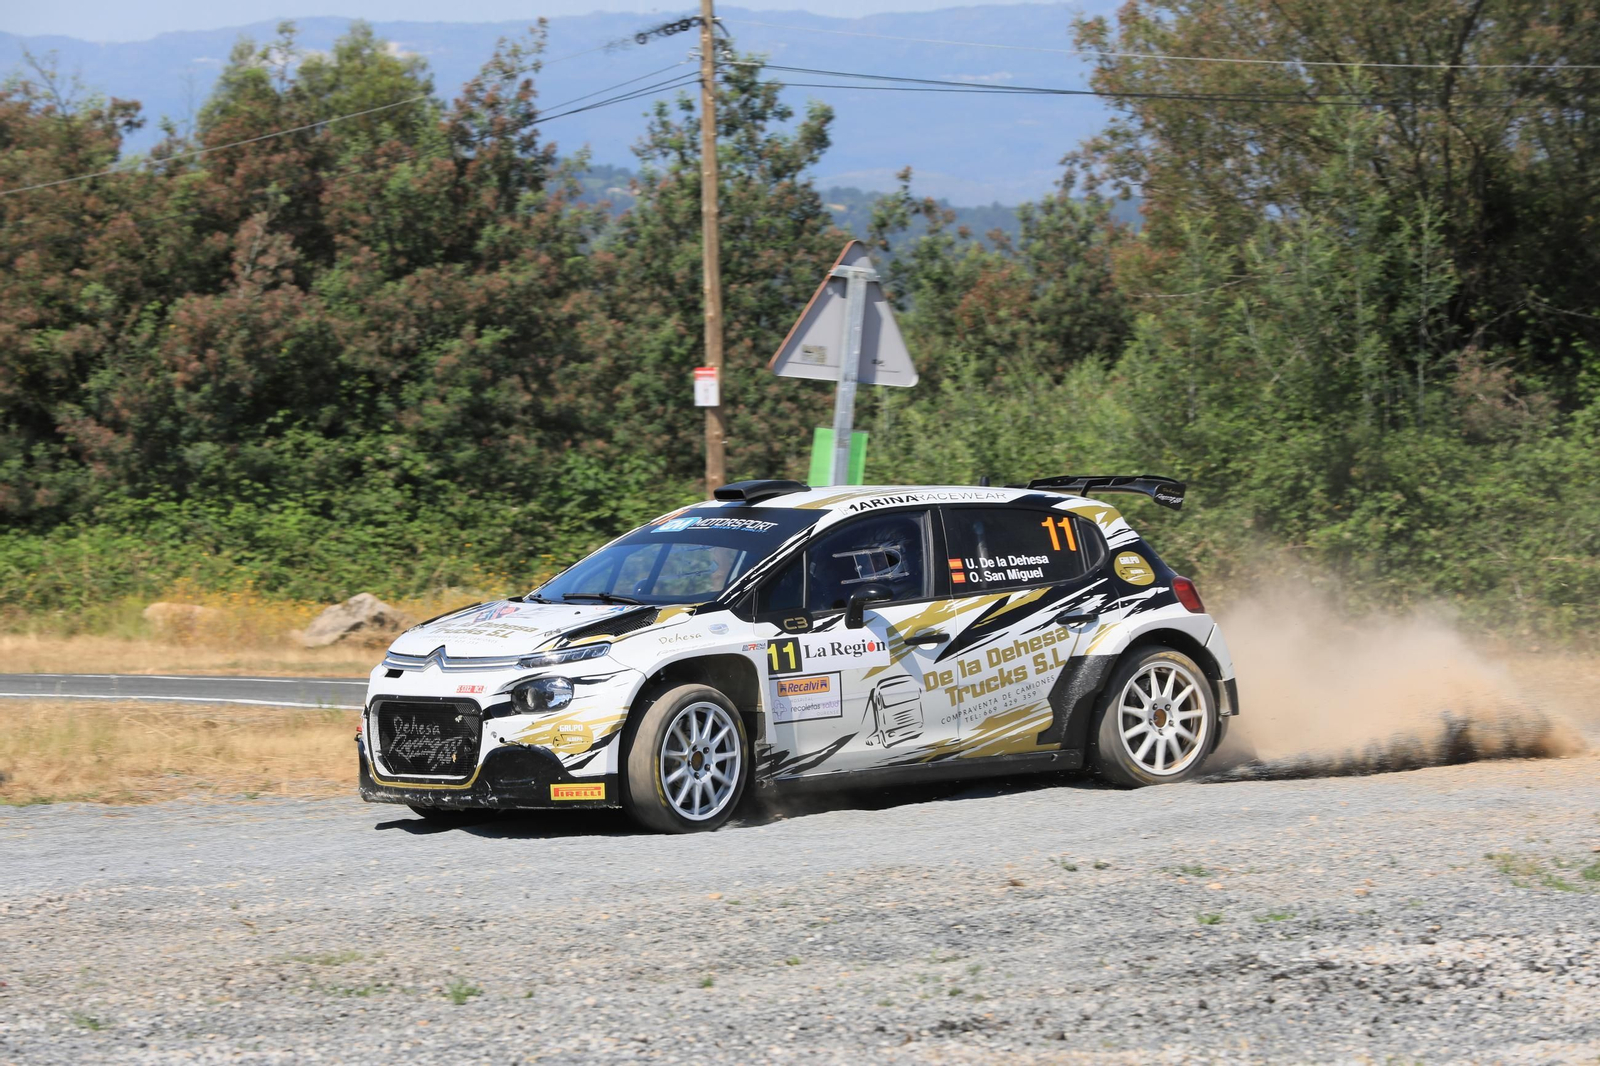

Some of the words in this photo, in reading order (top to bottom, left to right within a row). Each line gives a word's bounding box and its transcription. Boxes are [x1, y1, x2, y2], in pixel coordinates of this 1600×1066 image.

[691, 518, 779, 531] MOTORSPORT
[1041, 516, 1077, 552] 11
[965, 558, 978, 570] U.
[979, 557, 995, 568] De
[996, 556, 1008, 567] la
[1008, 554, 1050, 566] Dehesa
[969, 571, 983, 583] O.
[984, 570, 1006, 581] San
[1006, 567, 1044, 582] Miguel
[783, 617, 809, 630] C3
[658, 632, 702, 645] Dehesa
[767, 641, 796, 671] 11
[803, 644, 827, 659] La
[829, 639, 887, 658] Región
[923, 669, 954, 693] De
[957, 659, 982, 679] la
[986, 626, 1070, 669] Dehesa
[944, 664, 1029, 707] Trucks
[1032, 647, 1067, 675] S.L
[787, 680, 820, 693] Recalvi
[790, 702, 821, 713] recoletas
[822, 700, 840, 710] salud
[940, 697, 999, 725] COMPRAVENTA
[1002, 692, 1012, 701] DE
[1015, 675, 1056, 695] CAMIONES
[1003, 697, 1018, 708] 429
[1022, 690, 1037, 701] 359
[559, 724, 584, 732] GRUPO
[553, 786, 602, 797] PIRELLI
